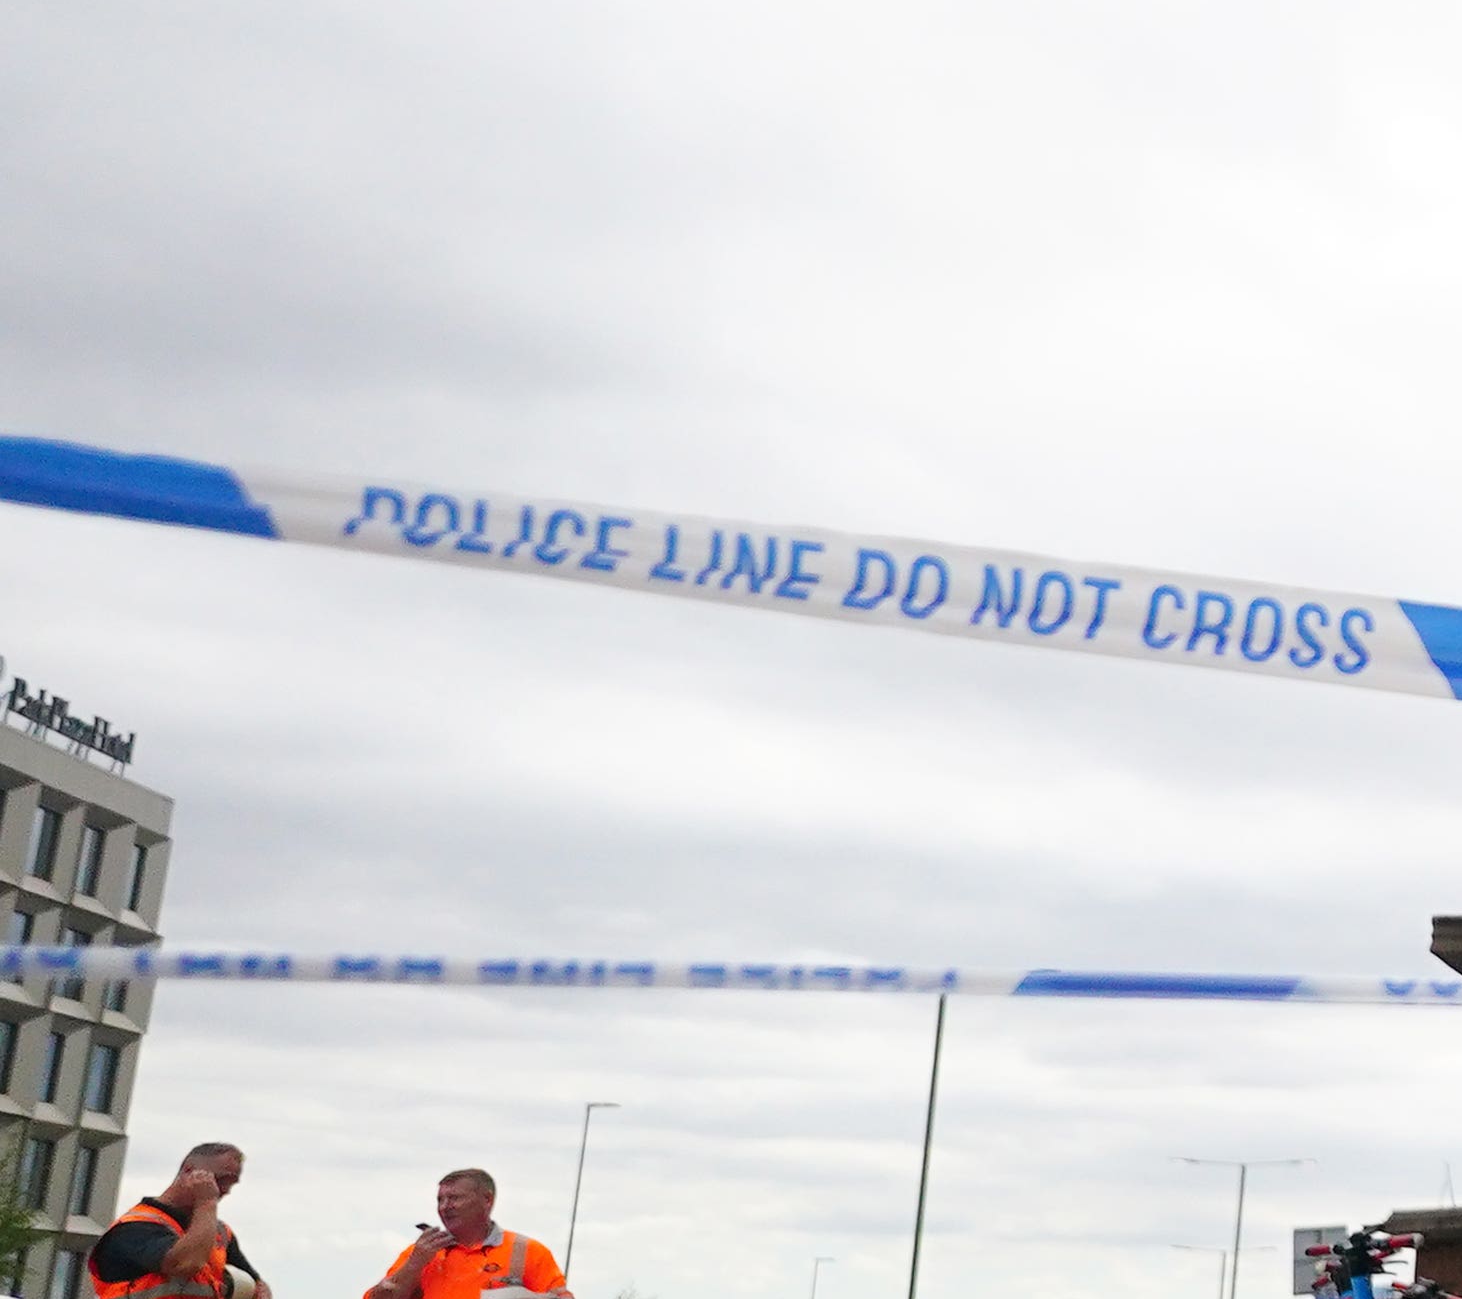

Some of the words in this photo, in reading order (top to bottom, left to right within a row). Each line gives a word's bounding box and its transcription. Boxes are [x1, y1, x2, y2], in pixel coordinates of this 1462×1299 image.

[651, 524, 824, 599] LINE
[843, 548, 949, 620] DO
[972, 564, 1122, 639] NOT
[1142, 584, 1375, 674] CROSS
